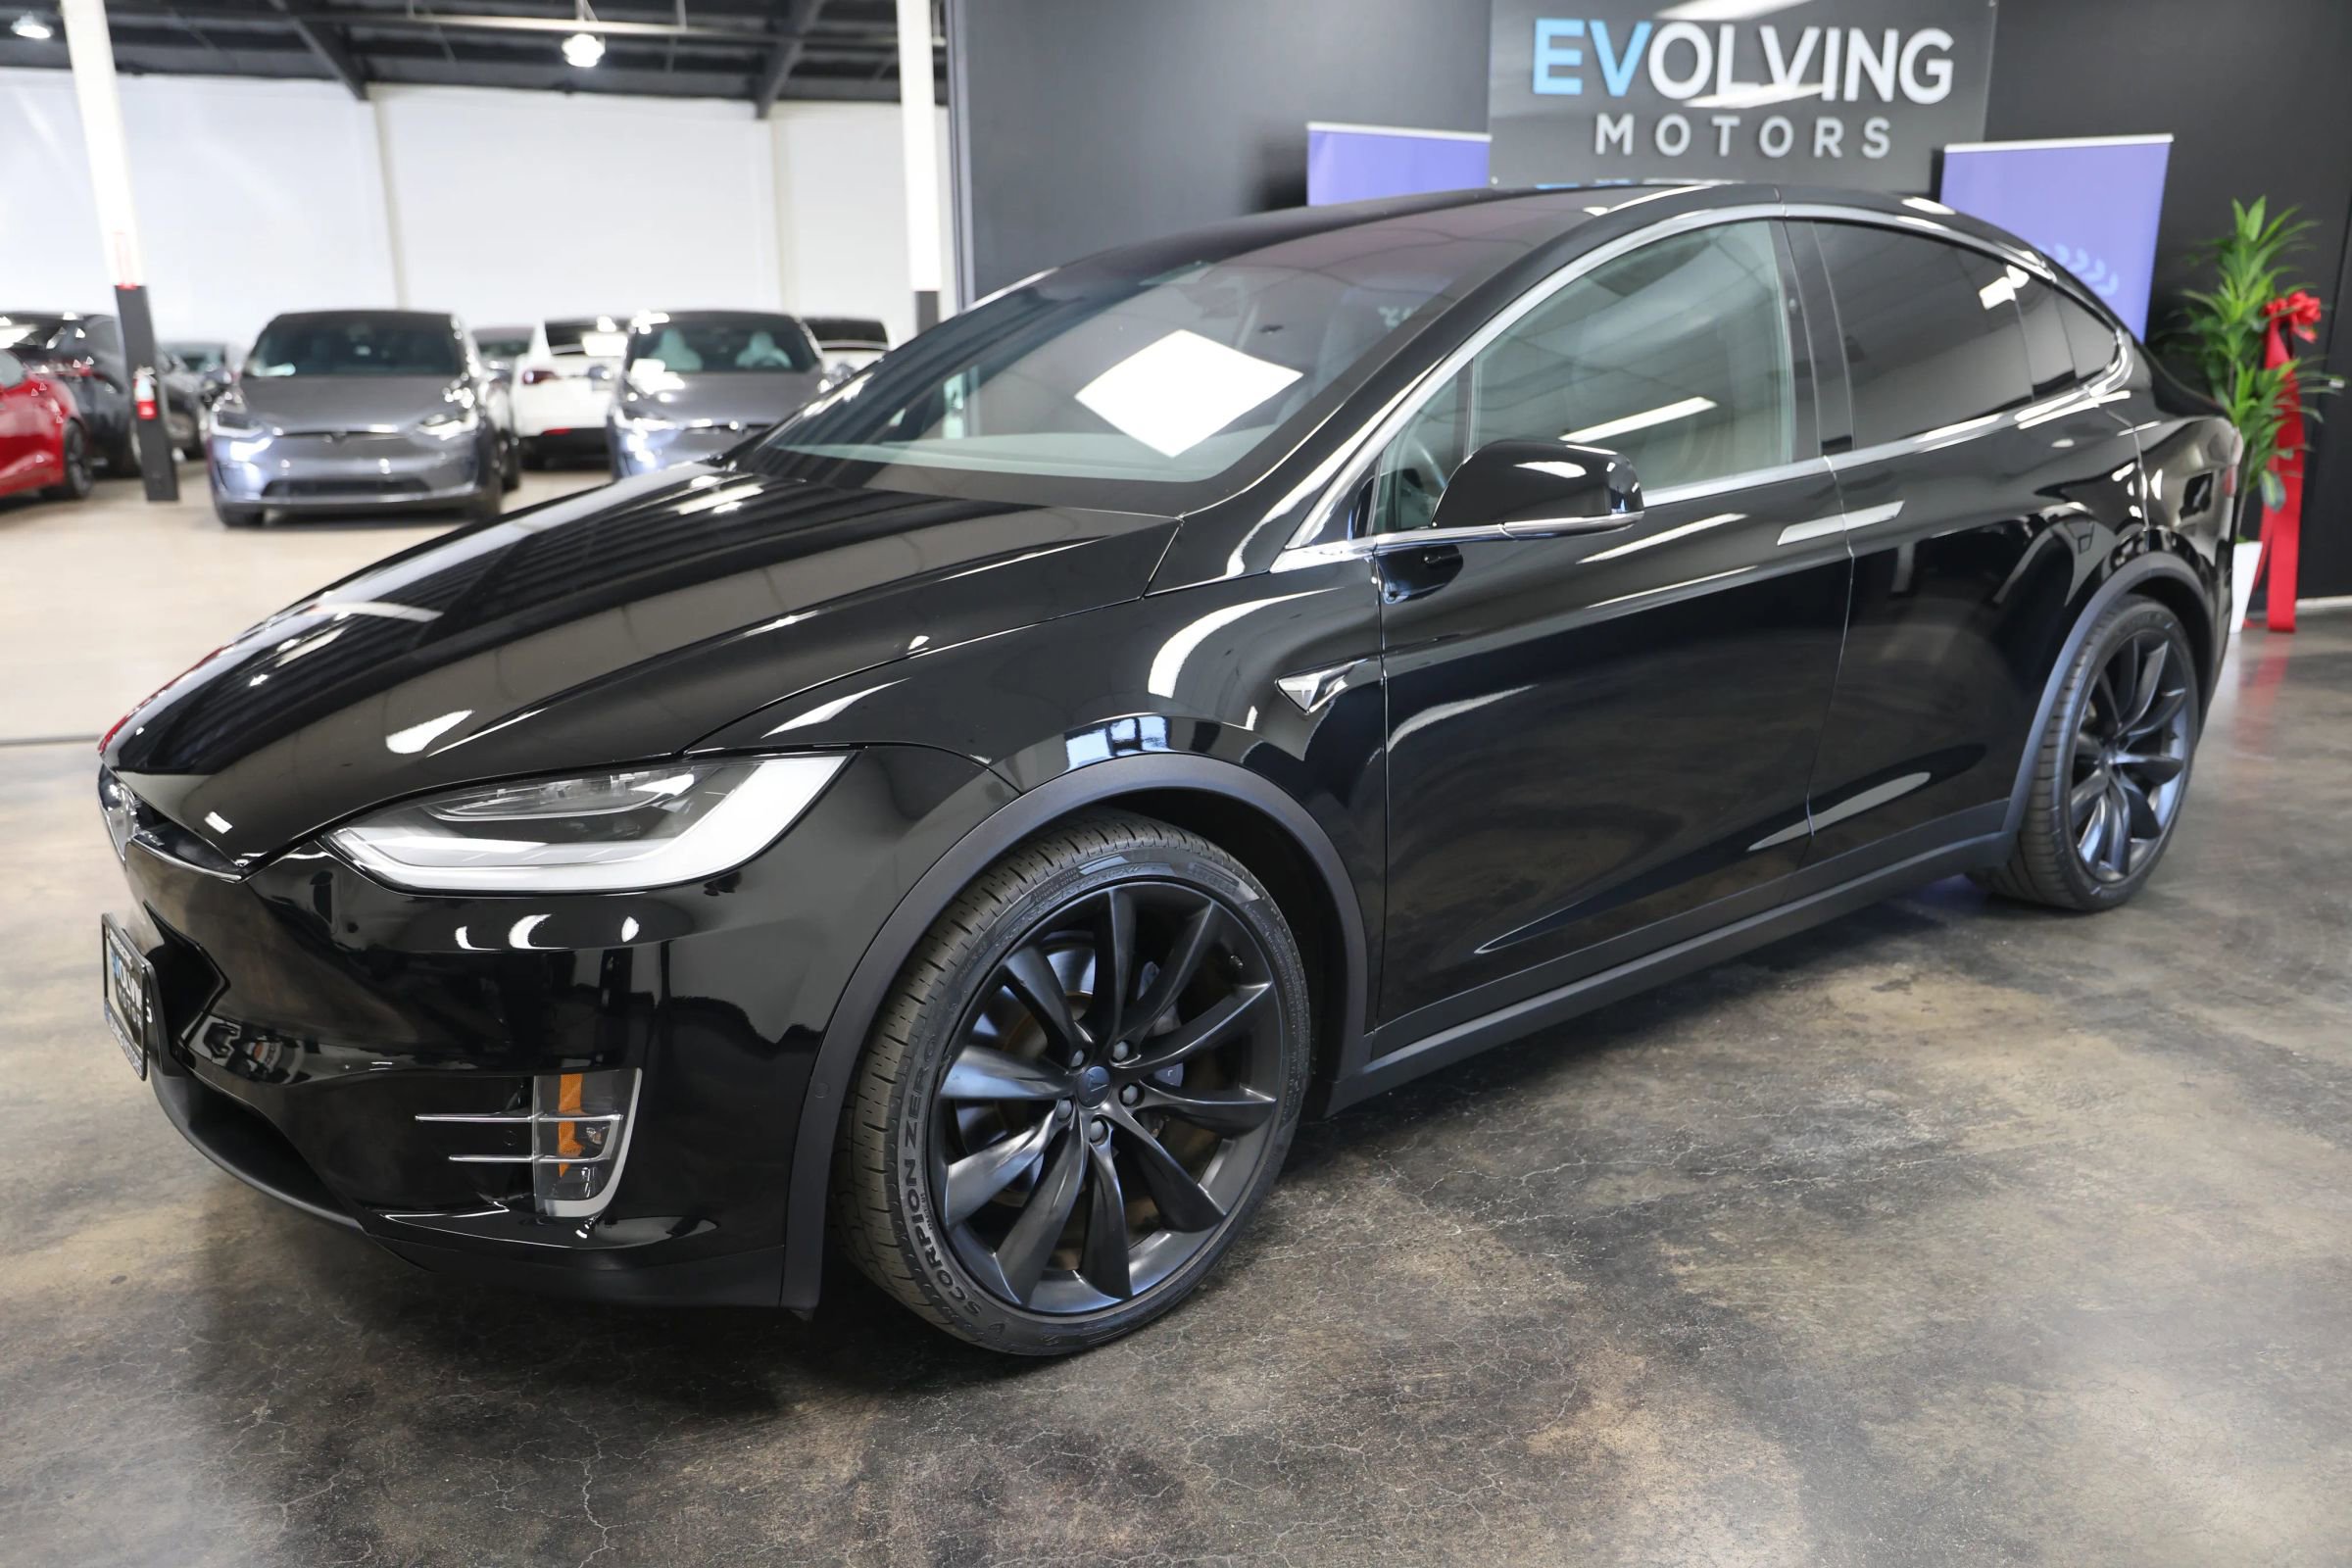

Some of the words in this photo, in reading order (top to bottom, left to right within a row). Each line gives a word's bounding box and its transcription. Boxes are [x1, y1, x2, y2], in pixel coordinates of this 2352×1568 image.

[1533, 18, 1954, 104] EVOLVING
[1594, 113, 1891, 159] MOTORS
[904, 1036, 936, 1148] ZERO
[904, 1157, 982, 1318] SCORPION
